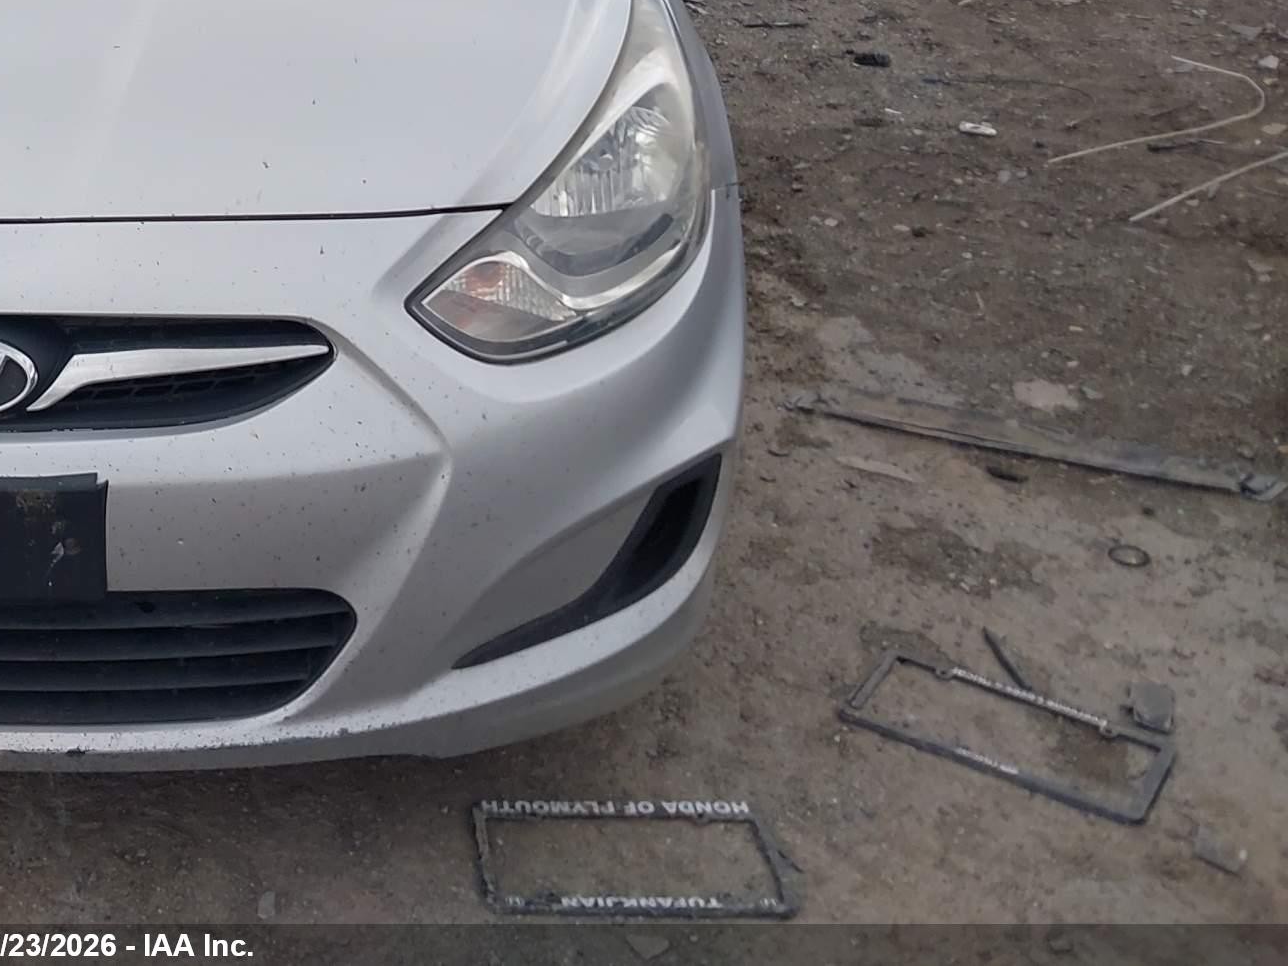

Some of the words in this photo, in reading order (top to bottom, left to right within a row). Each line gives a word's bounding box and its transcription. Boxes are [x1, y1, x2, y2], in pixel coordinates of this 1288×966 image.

[480, 800, 622, 815] PLYMOUTH
[624, 801, 655, 815] OF
[662, 800, 750, 814] HONDA
